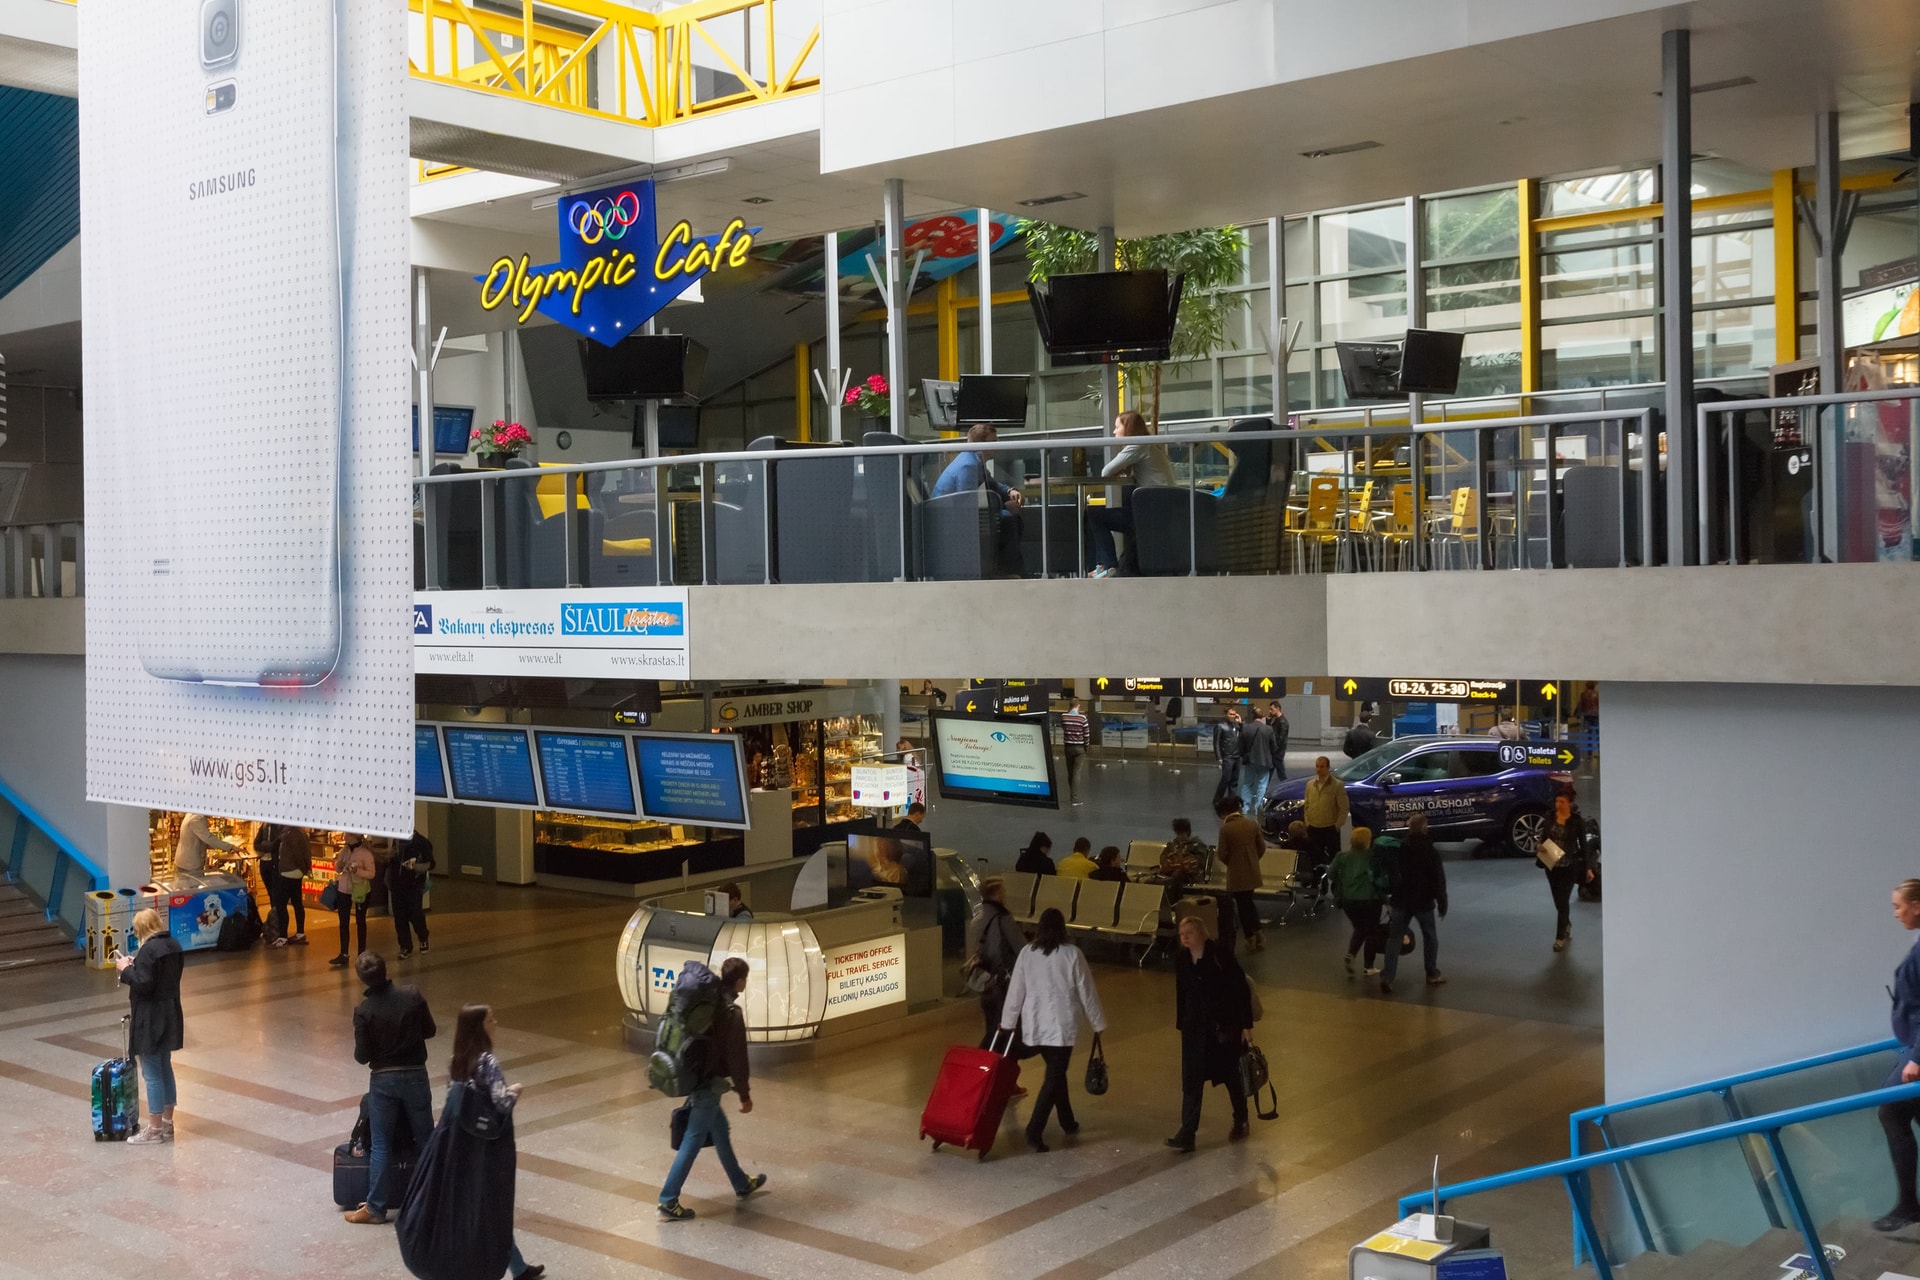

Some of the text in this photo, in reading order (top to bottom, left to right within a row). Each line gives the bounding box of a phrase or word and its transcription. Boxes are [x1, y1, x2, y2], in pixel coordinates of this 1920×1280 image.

[189, 168, 256, 200] SAMSUNG
[480, 218, 754, 324] Olympic Cafe
[490, 619, 555, 640] ekspresas
[428, 651, 474, 663] www.elta.lt
[518, 653, 562, 665] www.ve.lt
[610, 654, 685, 667] www.skrastas.lt
[1196, 678, 1231, 690] A1-A14
[1393, 682, 1466, 696] 19-24, 25-30
[1470, 690, 1498, 698] Check-in
[743, 700, 813, 718] AMBER SHOP
[1528, 747, 1557, 756] Tualetai
[1528, 756, 1553, 765] Toilets
[834, 945, 893, 965] TICKETING OFFICE
[827, 957, 899, 980] FULL TRAVEL SERVICE
[839, 971, 888, 990] BILIETŲ KASOS
[828, 981, 899, 1006] KELIONIŲ PASLAUGOS
